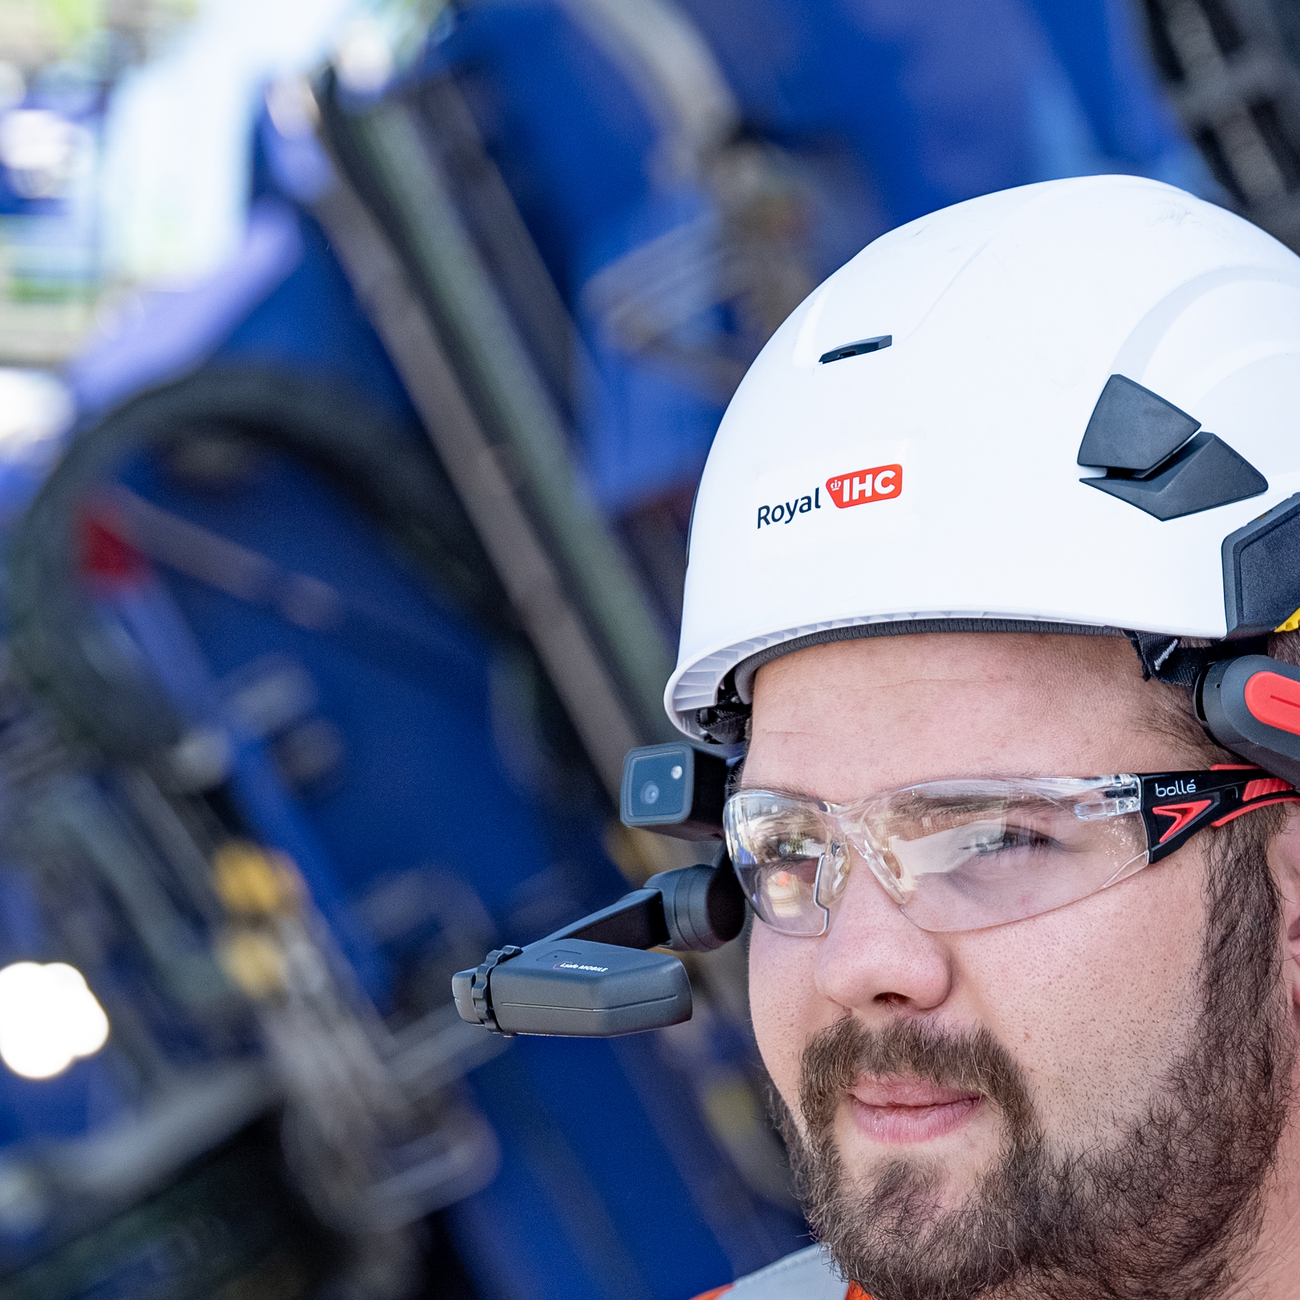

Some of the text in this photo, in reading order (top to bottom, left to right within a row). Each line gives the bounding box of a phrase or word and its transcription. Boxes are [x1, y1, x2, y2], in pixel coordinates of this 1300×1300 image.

[757, 470, 896, 529] Royal IHC
[1155, 778, 1197, 798] bollé
